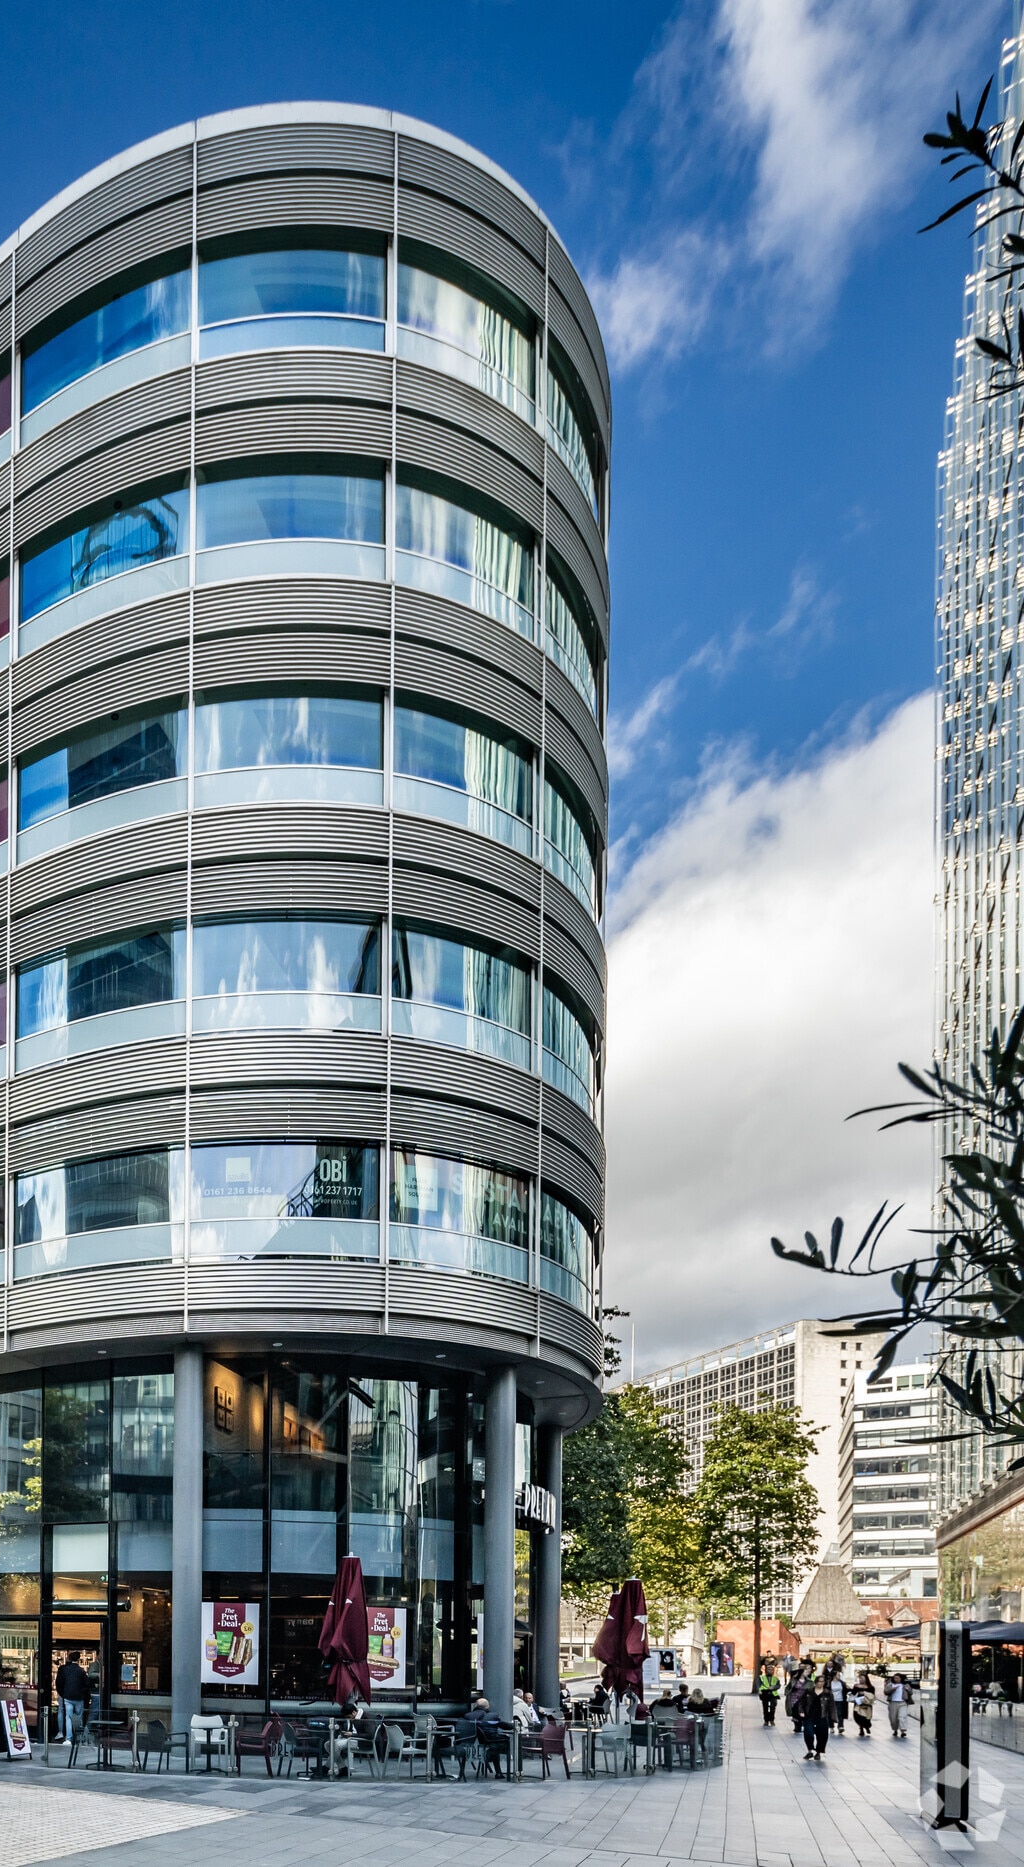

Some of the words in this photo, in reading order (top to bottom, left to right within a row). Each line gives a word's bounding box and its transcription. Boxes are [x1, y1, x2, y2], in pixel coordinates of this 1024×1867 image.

[204, 1188, 224, 1196] 0161
[227, 1187, 245, 1195] 236
[247, 1186, 272, 1194] 8644
[326, 1185, 341, 1195] 237
[342, 1187, 363, 1197] 1717
[492, 1212, 554, 1246] AVAILBLE
[947, 1634, 960, 1689] Spinningfields
